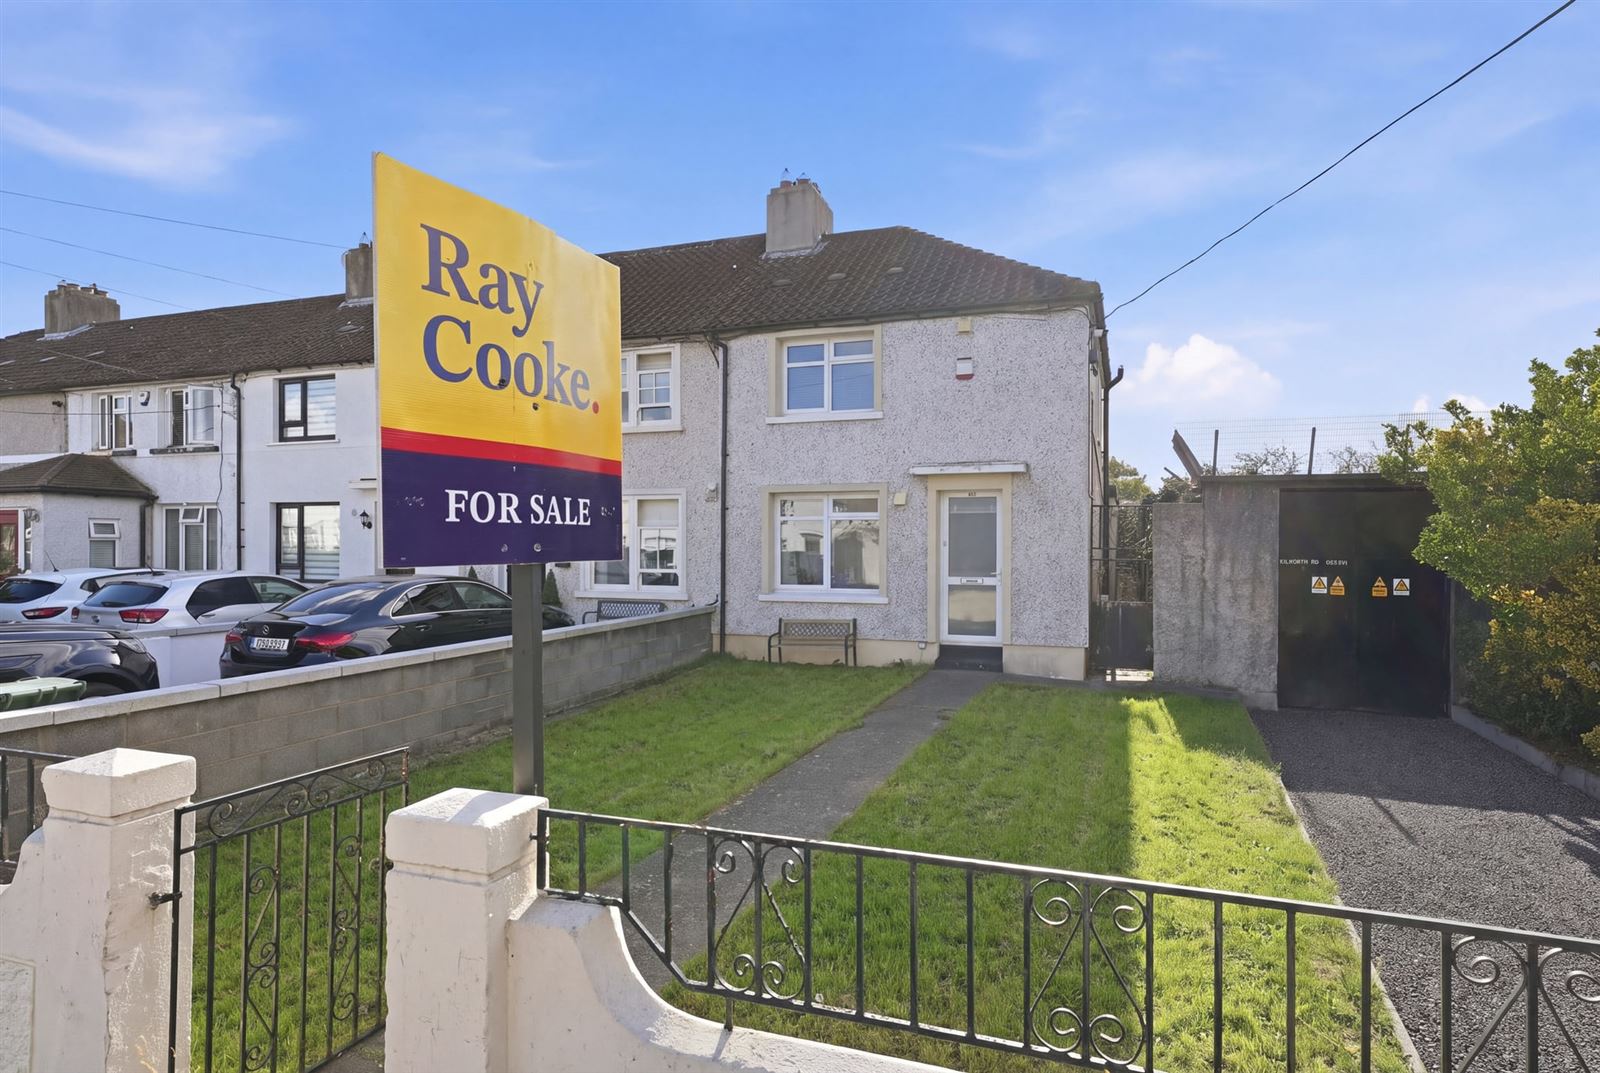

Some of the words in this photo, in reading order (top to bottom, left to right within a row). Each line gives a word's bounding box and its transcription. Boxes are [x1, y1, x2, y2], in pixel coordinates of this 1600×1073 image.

[420, 223, 544, 337] Ray
[423, 315, 599, 414] Cooke.
[445, 489, 522, 523] FOR
[530, 495, 591, 526] SALE
